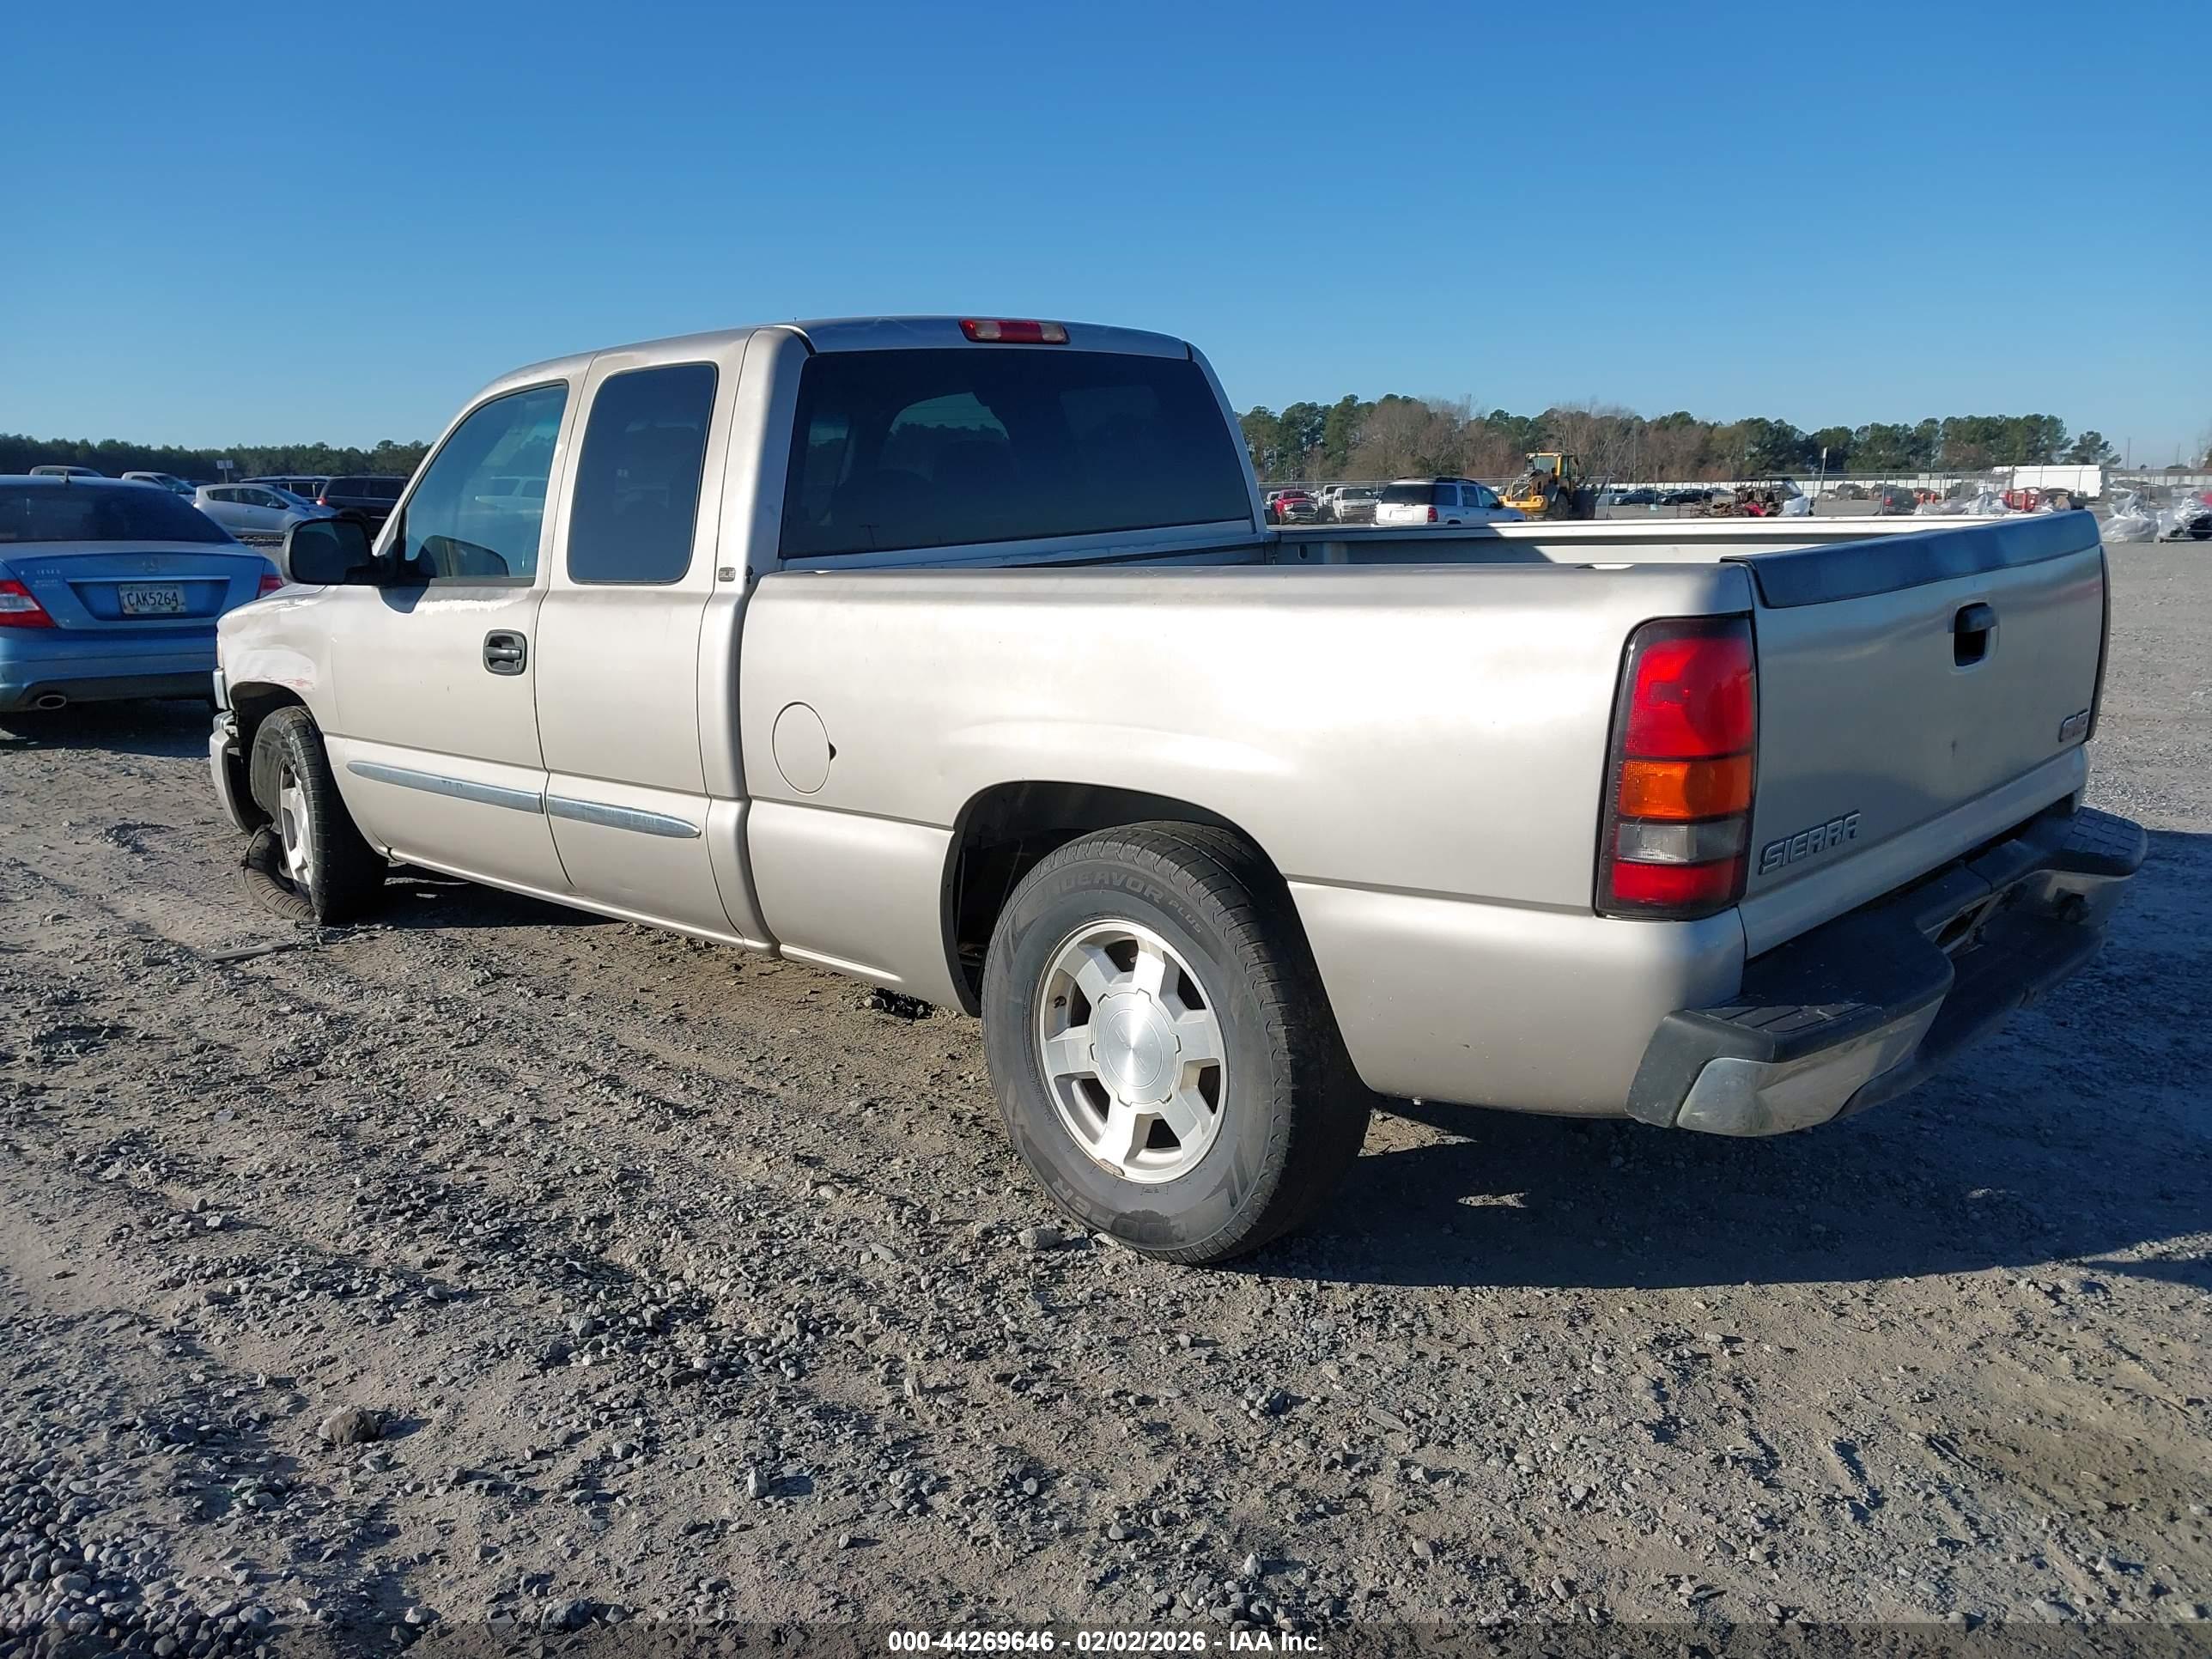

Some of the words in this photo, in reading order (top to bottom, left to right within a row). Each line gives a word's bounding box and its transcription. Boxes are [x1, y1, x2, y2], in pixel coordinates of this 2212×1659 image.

[127, 592, 179, 607] CAK5264
[1759, 811, 1862, 875] SIERRA
[1168, 899, 1204, 934] PLUS
